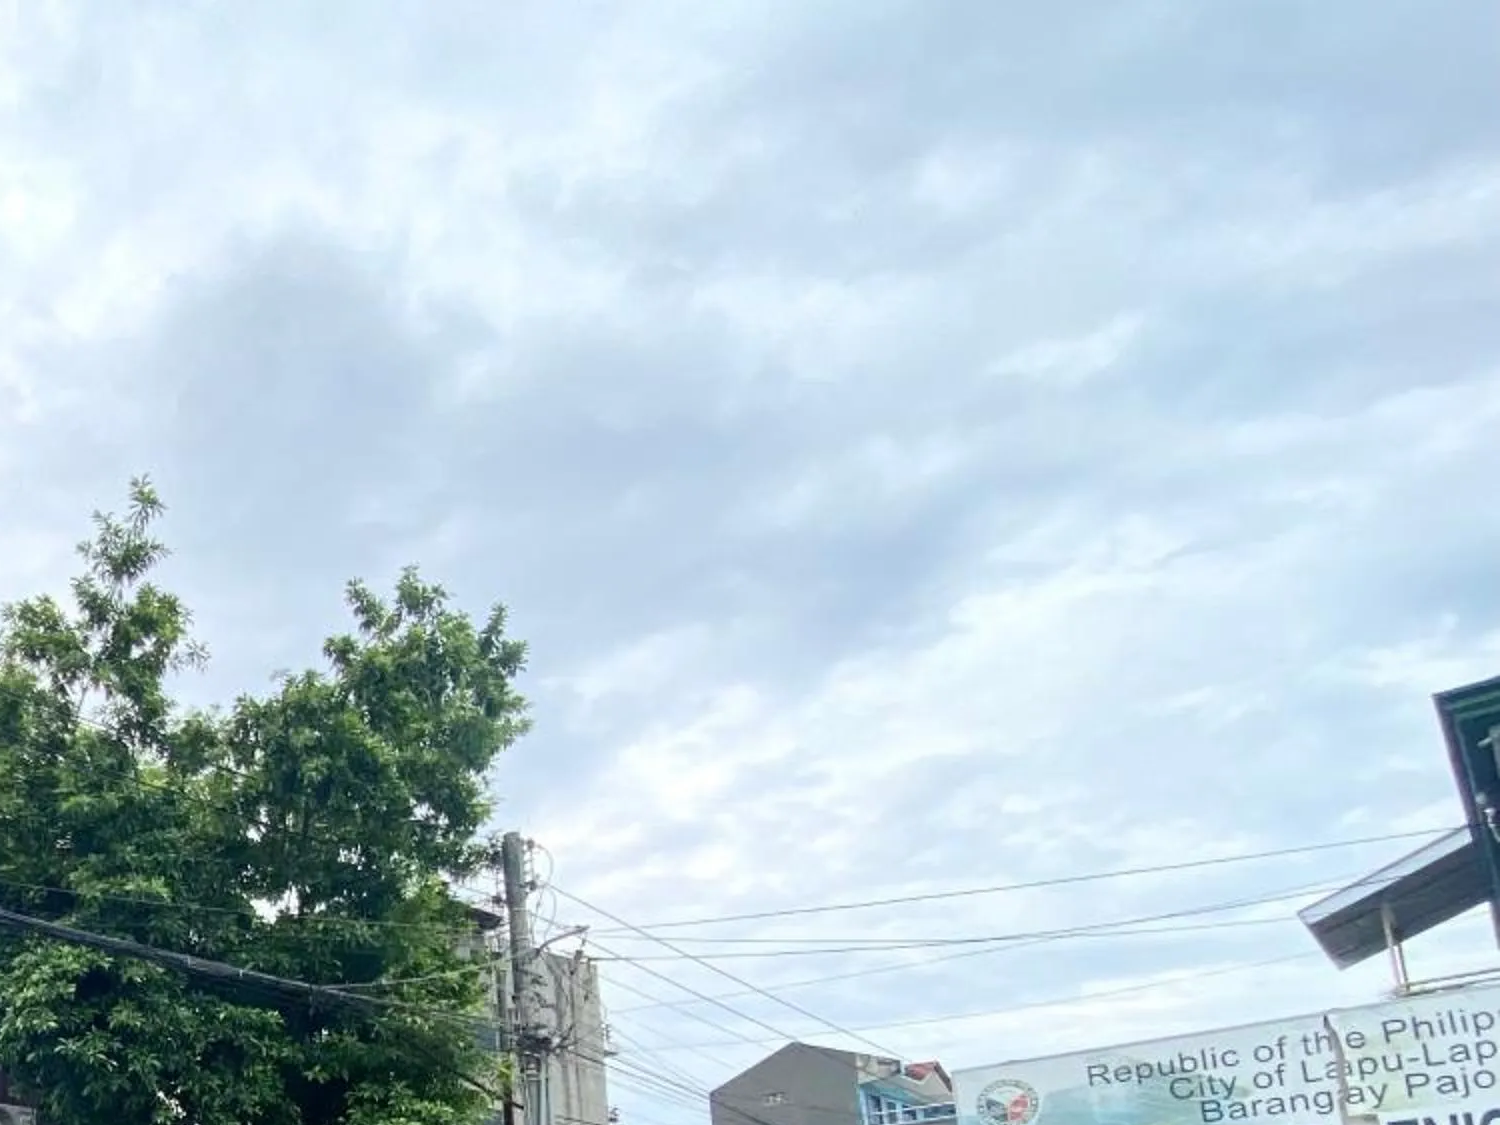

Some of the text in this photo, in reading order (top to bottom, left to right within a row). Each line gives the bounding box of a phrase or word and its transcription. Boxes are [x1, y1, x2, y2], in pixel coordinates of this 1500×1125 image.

[1087, 1008, 1500, 1087] Republic of the Philip
[1169, 1071, 1237, 1103] City
[1253, 1062, 1285, 1090] of
[1201, 1066, 1496, 1125] Barangay Pajo
